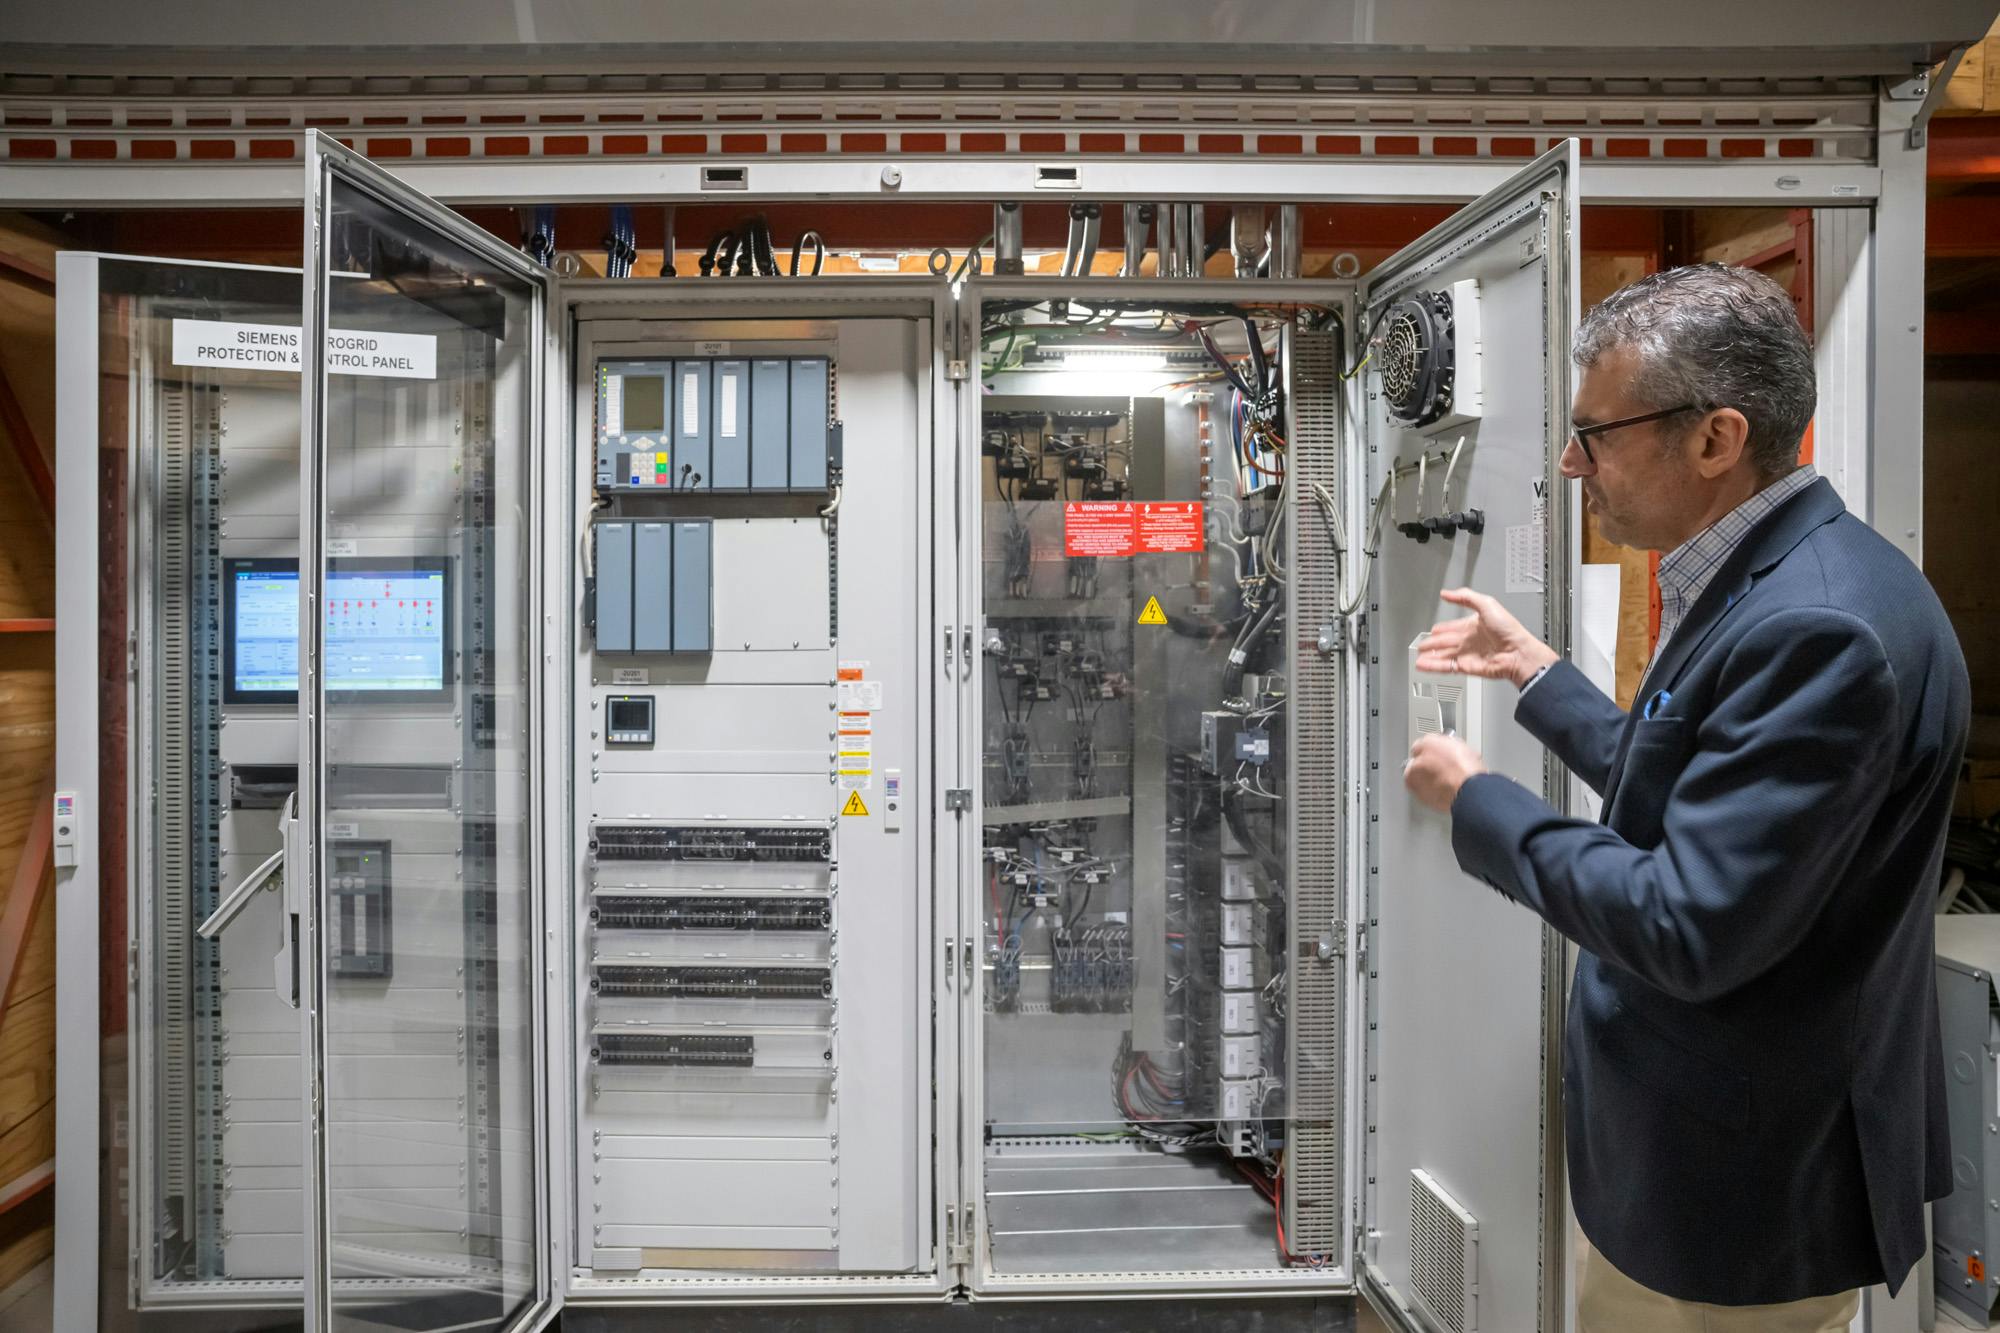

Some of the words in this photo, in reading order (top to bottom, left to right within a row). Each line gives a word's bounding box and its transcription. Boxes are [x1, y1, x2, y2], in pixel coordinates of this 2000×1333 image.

[237, 331, 298, 346] SIEMENS
[328, 336, 378, 351] ROGRID
[197, 346, 287, 363] PROTECTION
[291, 352, 300, 364] &
[328, 354, 369, 367] NTROL
[372, 356, 415, 370] PANEL
[1081, 504, 1118, 512] WARNING
